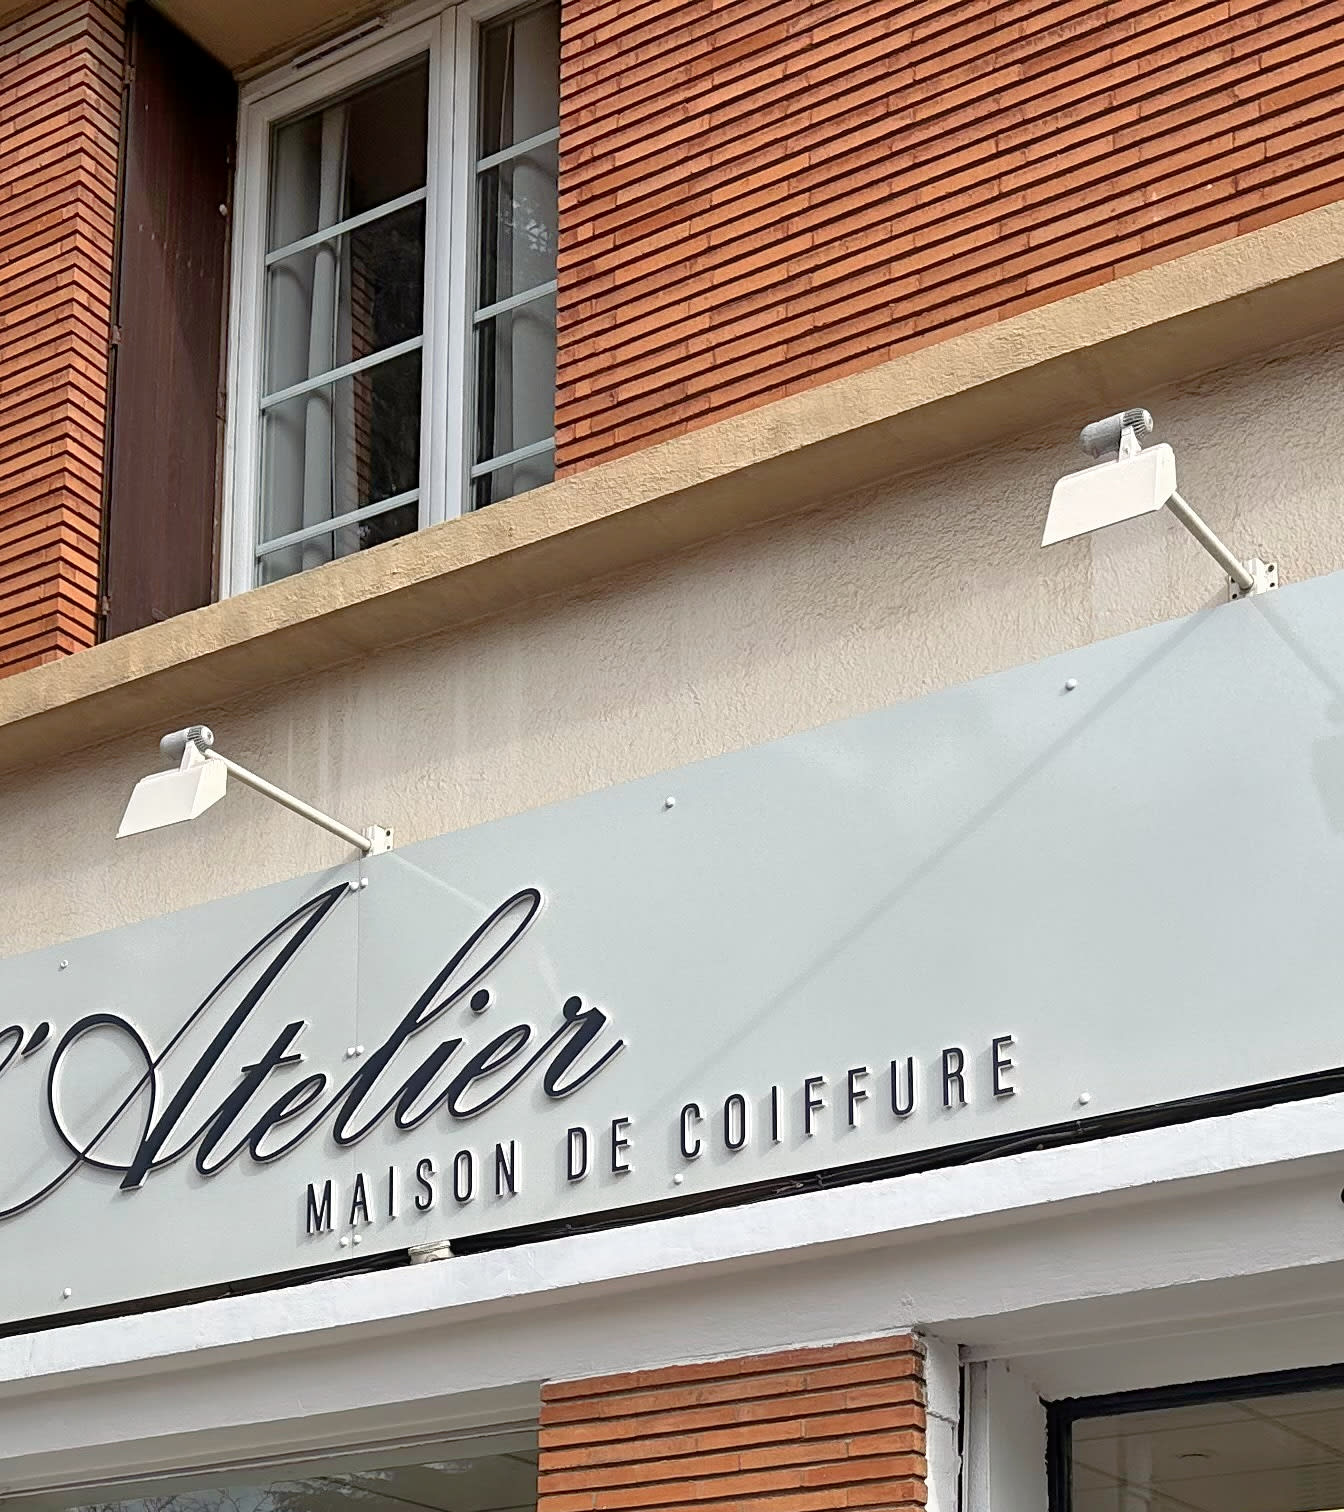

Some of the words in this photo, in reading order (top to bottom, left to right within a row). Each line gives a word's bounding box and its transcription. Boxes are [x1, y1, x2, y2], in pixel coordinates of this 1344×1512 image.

[306, 1139, 520, 1235] MAISON
[567, 1115, 633, 1178] DE
[680, 1034, 1019, 1158] COIFFURE
